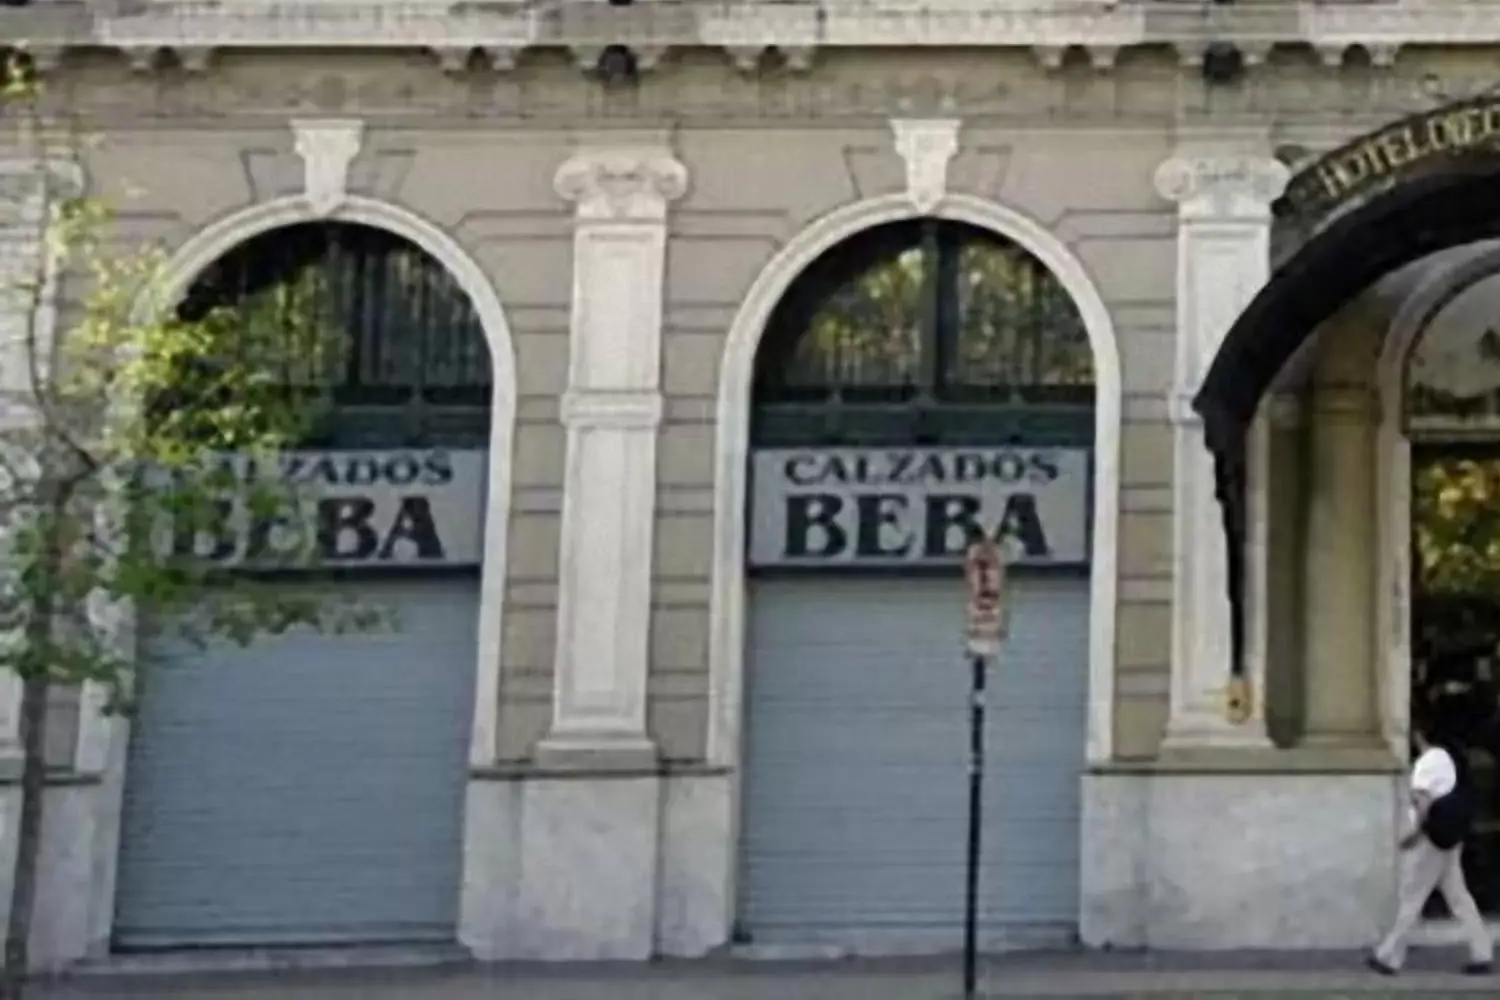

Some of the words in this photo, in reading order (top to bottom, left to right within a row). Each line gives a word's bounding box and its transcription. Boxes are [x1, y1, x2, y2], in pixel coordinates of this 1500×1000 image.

[1318, 129, 1430, 198] HOTEL
[784, 452, 1060, 486] CALZADOS
[785, 492, 1052, 559] BEBA
